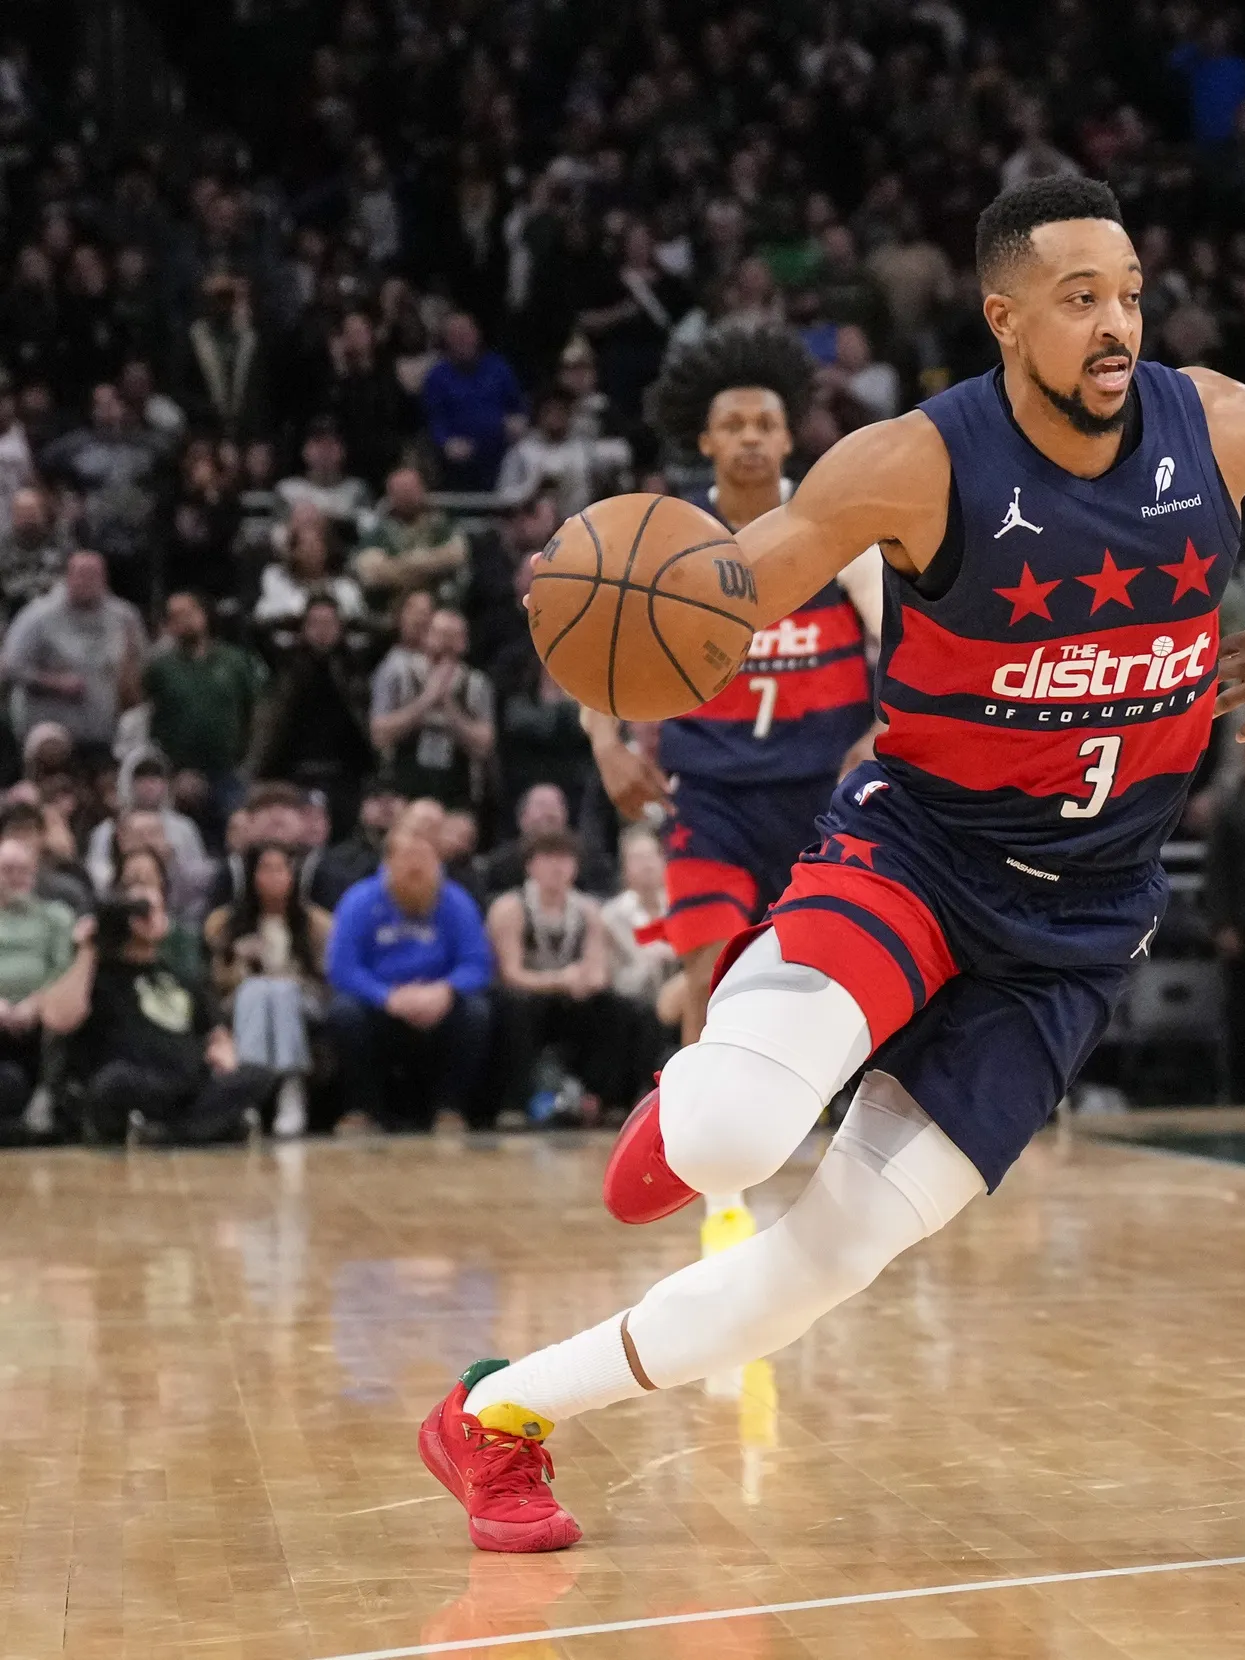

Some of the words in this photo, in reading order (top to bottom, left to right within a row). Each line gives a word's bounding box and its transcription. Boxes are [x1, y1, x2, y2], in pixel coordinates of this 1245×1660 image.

[1141, 493, 1202, 518] Robinhood
[991, 631, 1211, 699] district
[1060, 643, 1099, 660] THE
[748, 676, 778, 739] 7
[984, 704, 1017, 720] OF
[1038, 690, 1196, 723] COLUMBIA
[1060, 735, 1123, 819] 3
[1006, 856, 1060, 882] WASHINGTON
